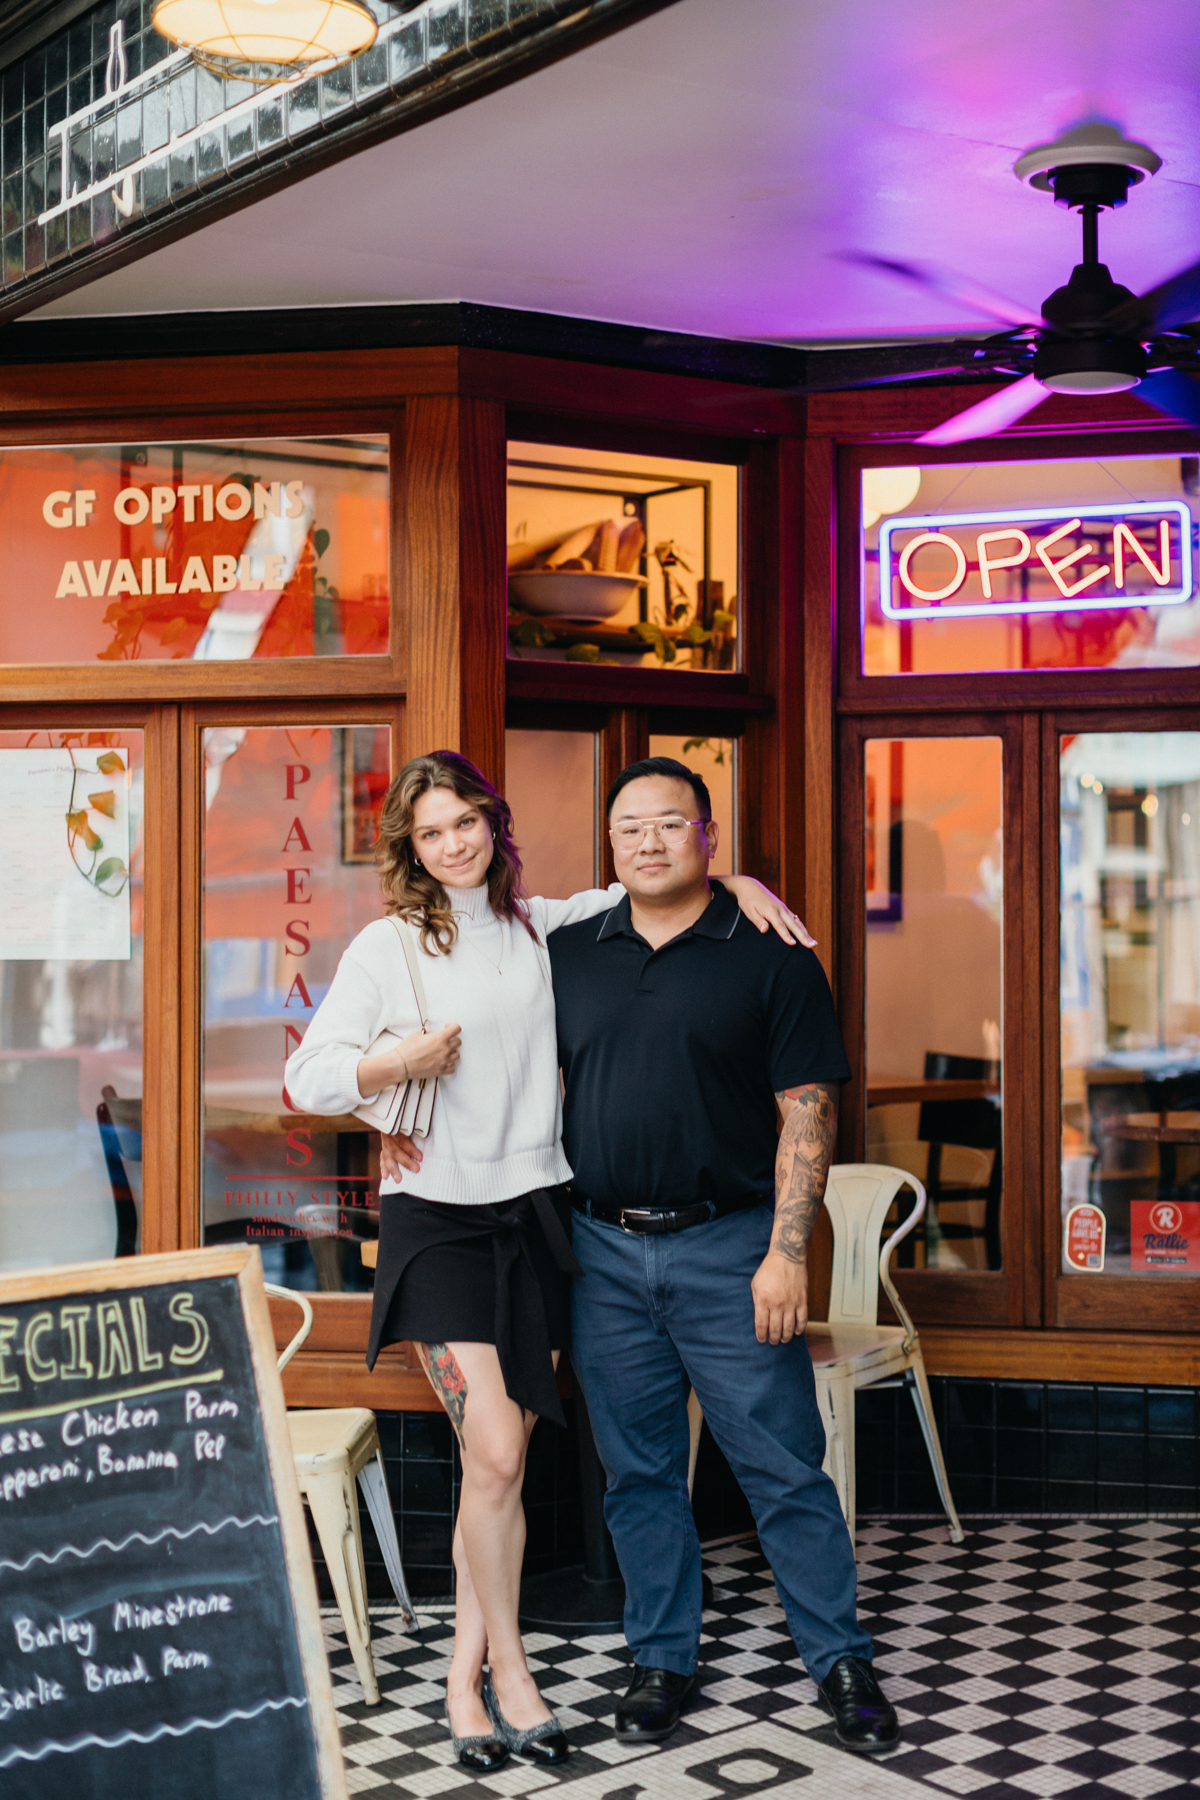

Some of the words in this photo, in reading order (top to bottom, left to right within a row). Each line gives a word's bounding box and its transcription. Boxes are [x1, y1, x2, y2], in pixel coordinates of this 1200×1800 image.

[43, 489, 97, 528] GF
[113, 480, 304, 526] OPTIONS
[55, 554, 288, 598] AVAILABLE
[898, 517, 1171, 601] OPEN
[281, 763, 314, 1167] PAESANS
[224, 1190, 298, 1206] PHILLY
[309, 1190, 375, 1207] STYLE
[251, 1212, 317, 1224] sandwiches
[322, 1212, 348, 1224] wih
[1156, 1207, 1175, 1228] R
[246, 1224, 285, 1237] Italian
[289, 1225, 354, 1240] inspiration
[0, 1427, 46, 1457] ese
[61, 1400, 159, 1447] Chicken
[185, 1389, 239, 1423] Parm
[0, 1456, 94, 1502] pperoni,
[13, 1614, 96, 1657] Barley
[113, 1594, 232, 1632] Minestrone
[163, 1648, 211, 1677] Parm
